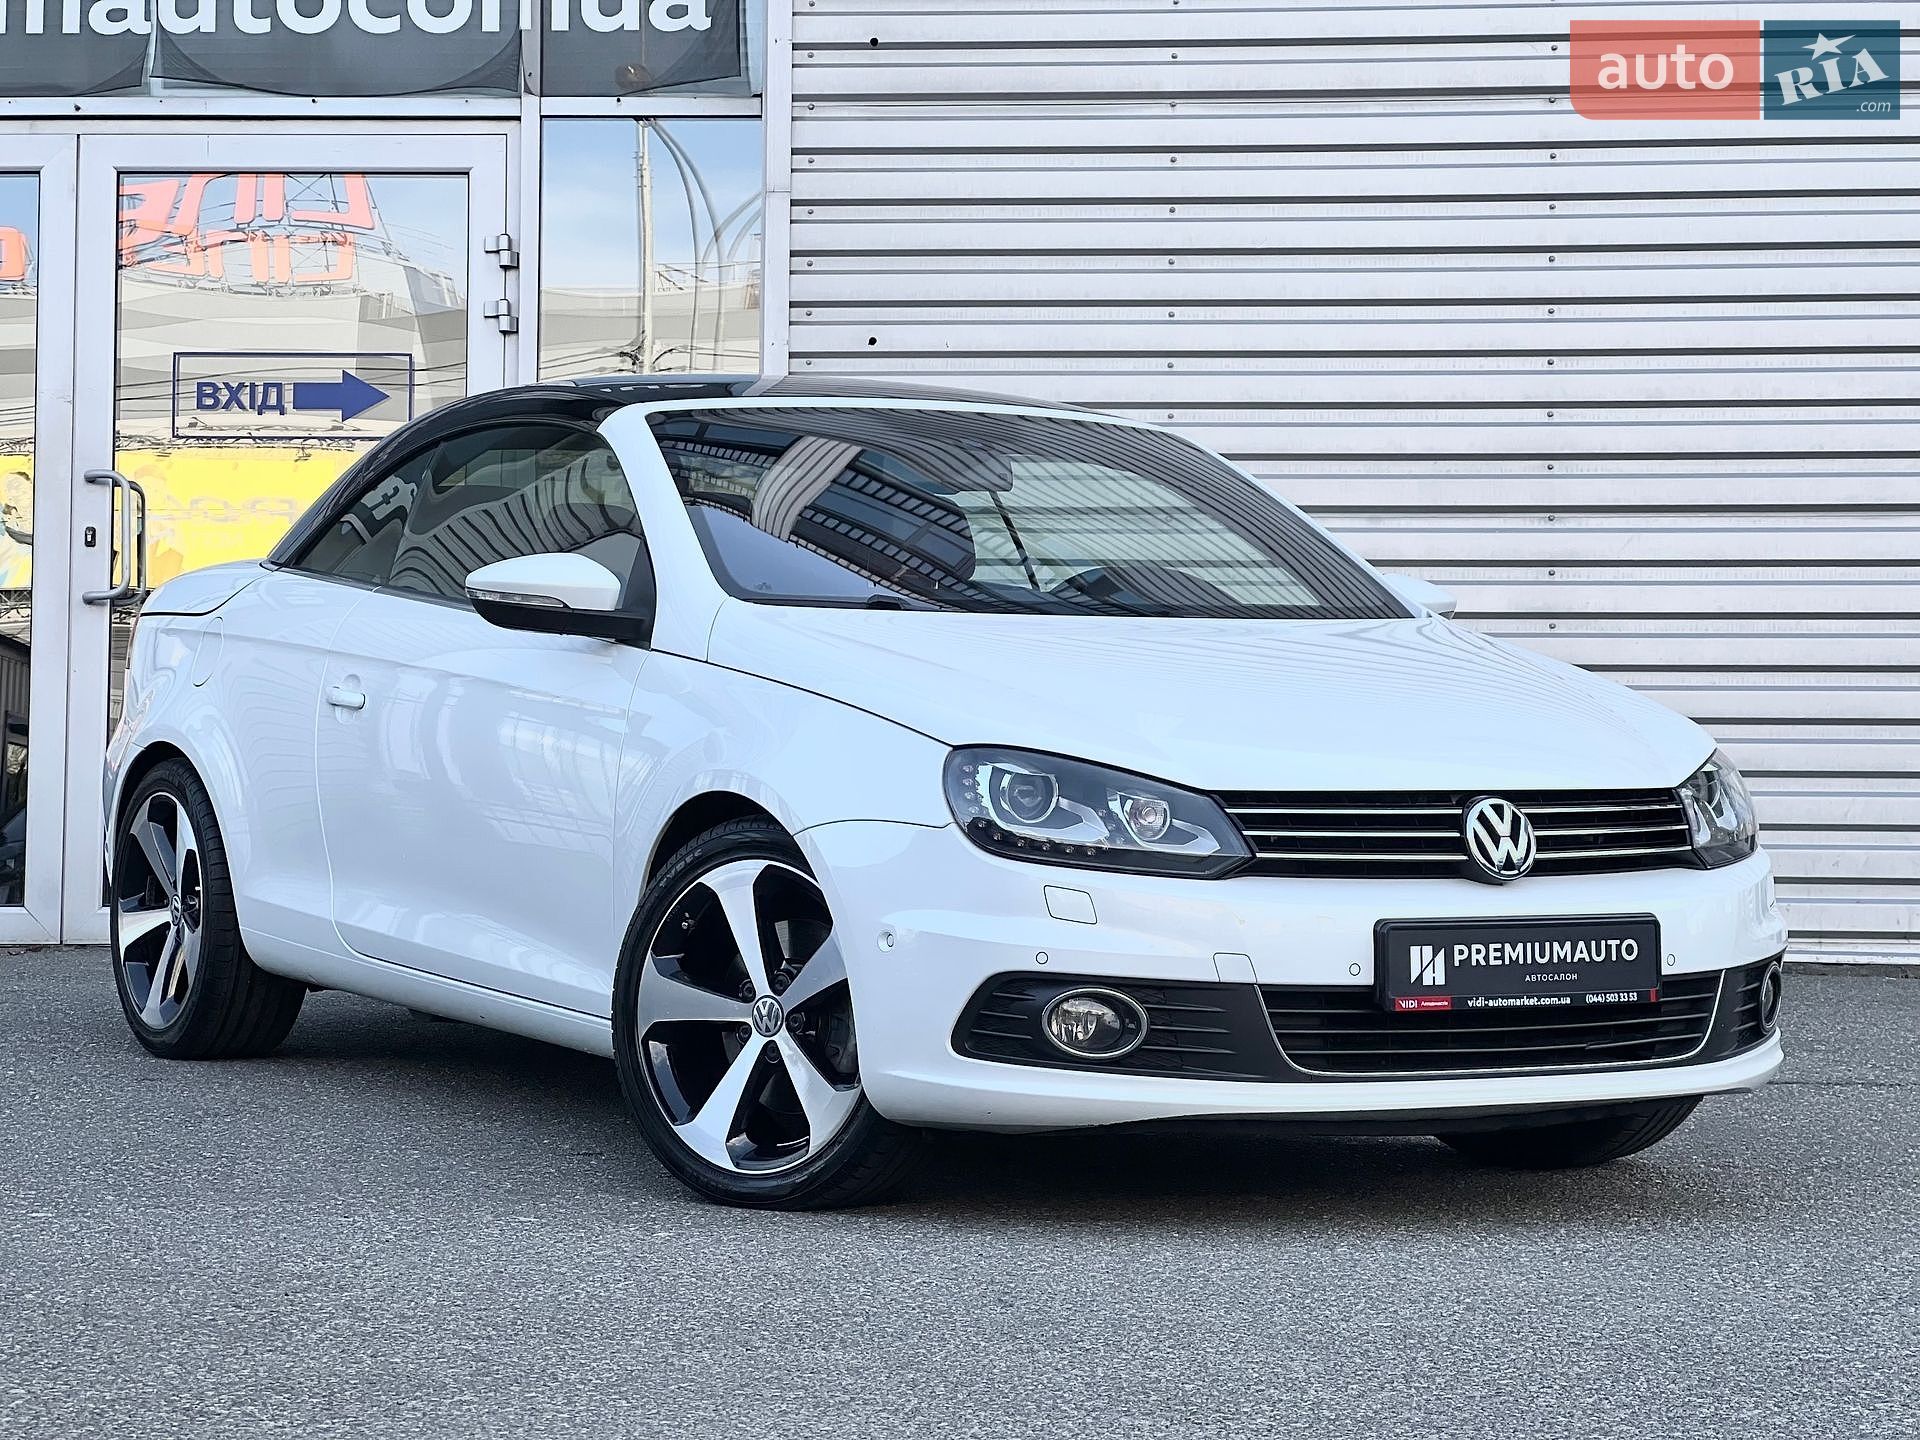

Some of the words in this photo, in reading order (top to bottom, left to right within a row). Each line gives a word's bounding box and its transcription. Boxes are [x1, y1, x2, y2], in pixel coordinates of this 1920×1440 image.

[196, 382, 285, 416] ВХІД
[1453, 938, 1639, 967] PREMIUMAUTO
[1525, 972, 1579, 983] АВТОСАЛОН
[1467, 995, 1571, 1008] vidi-automarket.com.ua
[1585, 993, 1605, 1004] (044)
[1606, 993, 1619, 1003] 503
[1619, 992, 1628, 1002] 33
[1629, 992, 1638, 1002] 53
[1399, 1000, 1418, 1009] VIDI
